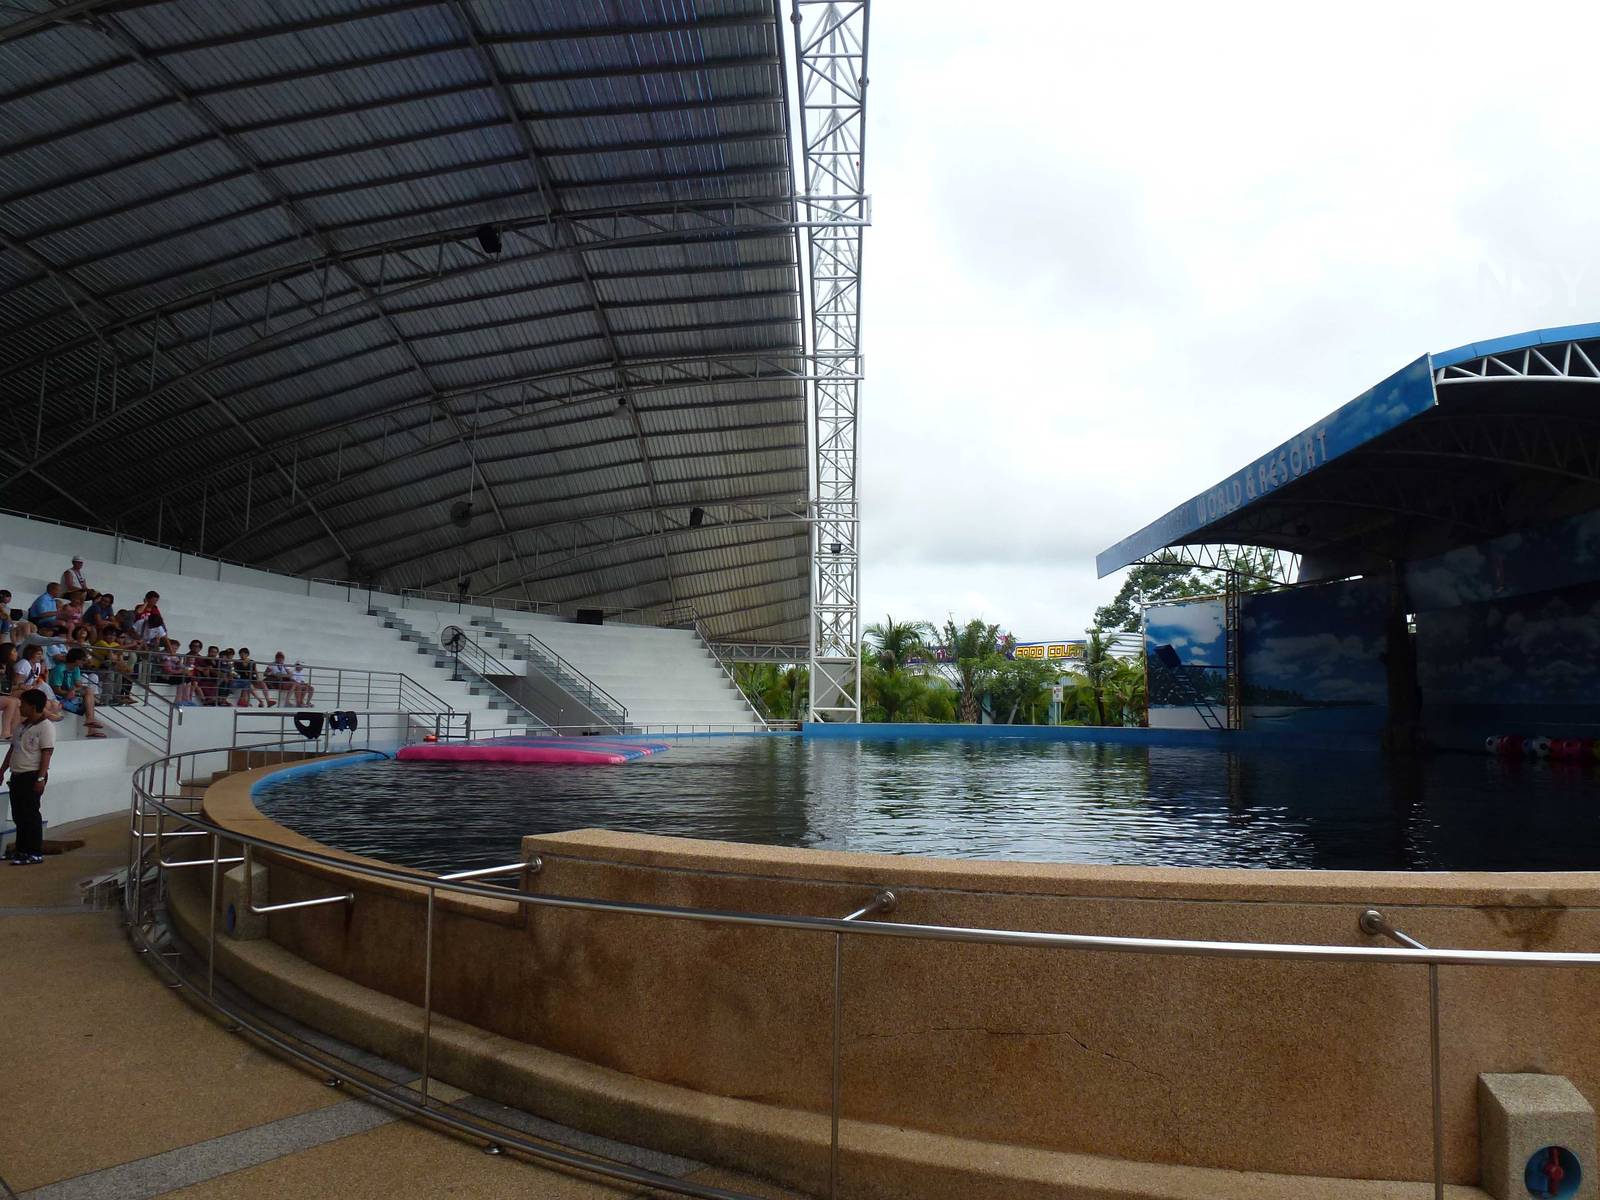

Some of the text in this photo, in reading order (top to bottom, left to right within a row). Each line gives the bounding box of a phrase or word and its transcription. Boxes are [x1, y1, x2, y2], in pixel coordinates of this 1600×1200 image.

[1196, 479, 1242, 526] WORLD
[1246, 468, 1257, 499] &
[1016, 646, 1044, 658] FOOD
